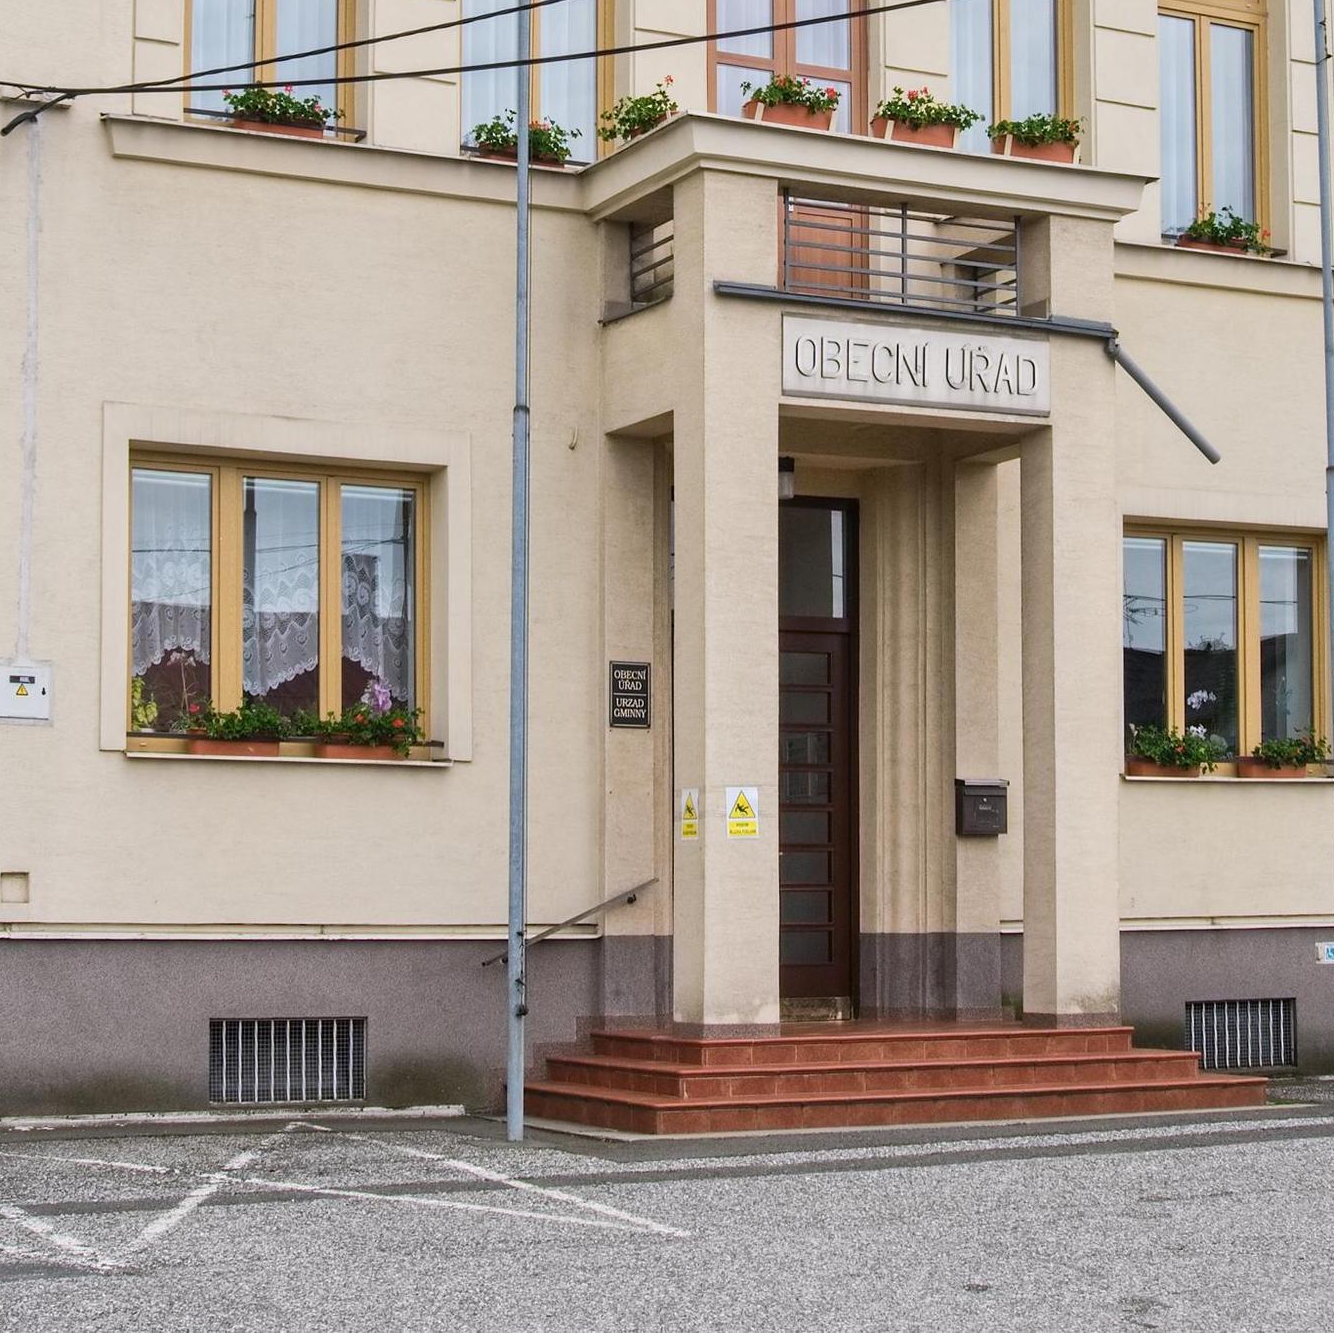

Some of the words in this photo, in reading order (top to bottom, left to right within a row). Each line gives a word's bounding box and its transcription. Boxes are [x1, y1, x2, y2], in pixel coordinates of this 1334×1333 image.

[795, 334, 930, 388] OBECNÍ
[945, 343, 1037, 396] ÚŘAD
[613, 668, 647, 680] OBECNÍ
[613, 708, 647, 719] GMINNY
